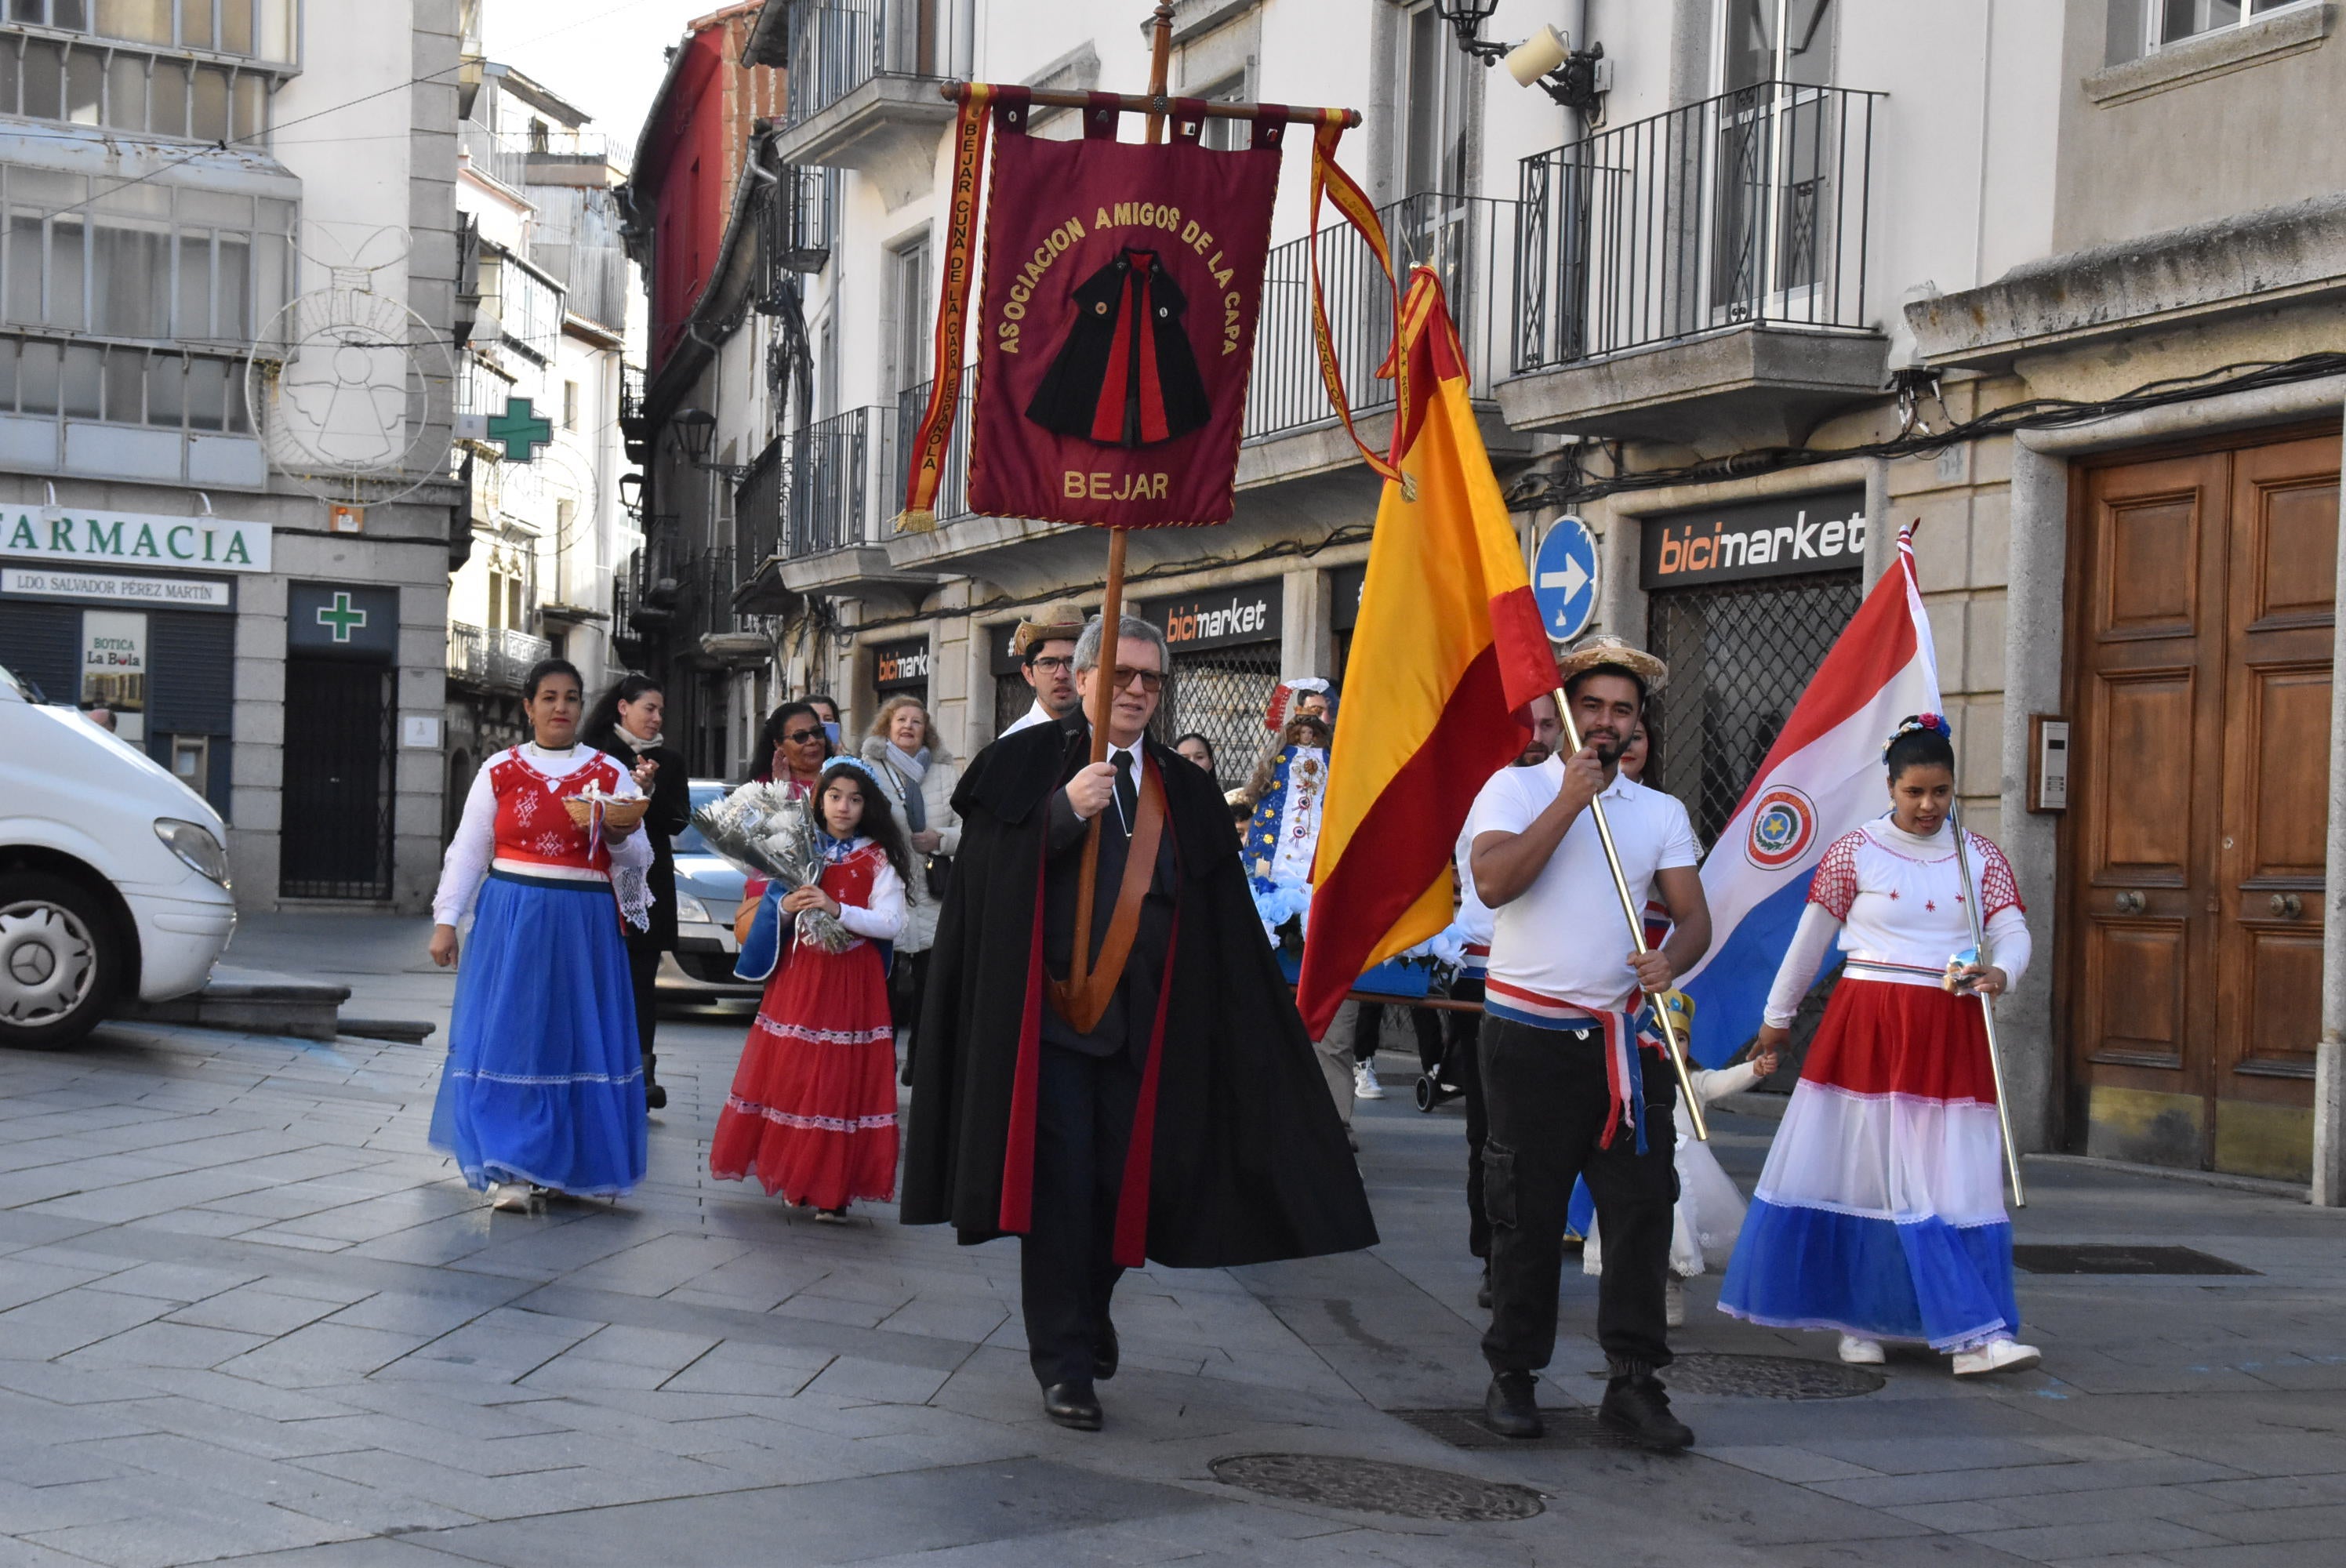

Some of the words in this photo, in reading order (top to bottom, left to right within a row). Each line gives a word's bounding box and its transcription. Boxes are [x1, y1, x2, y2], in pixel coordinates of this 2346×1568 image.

[953, 201, 969, 250] CUNA
[950, 257, 963, 283] DE
[999, 216, 1085, 354] ASOCIACION
[1095, 201, 1179, 232] AMIGOS
[1181, 220, 1214, 255] DE
[1208, 251, 1234, 289] LA
[1222, 291, 1241, 356] CAPA
[948, 290, 958, 314] LA
[948, 321, 958, 372] CAPA
[1064, 470, 1168, 501] BEJAR
[0, 513, 252, 564] ARMACIA
[1658, 510, 1865, 575] bicimarket
[50, 577, 116, 594] SALVADOR
[1166, 597, 1266, 644] bicimarket
[87, 651, 104, 665] La
[107, 652, 140, 666] Bola
[94, 637, 135, 651] BOTICA
[879, 646, 929, 682] bicimark
